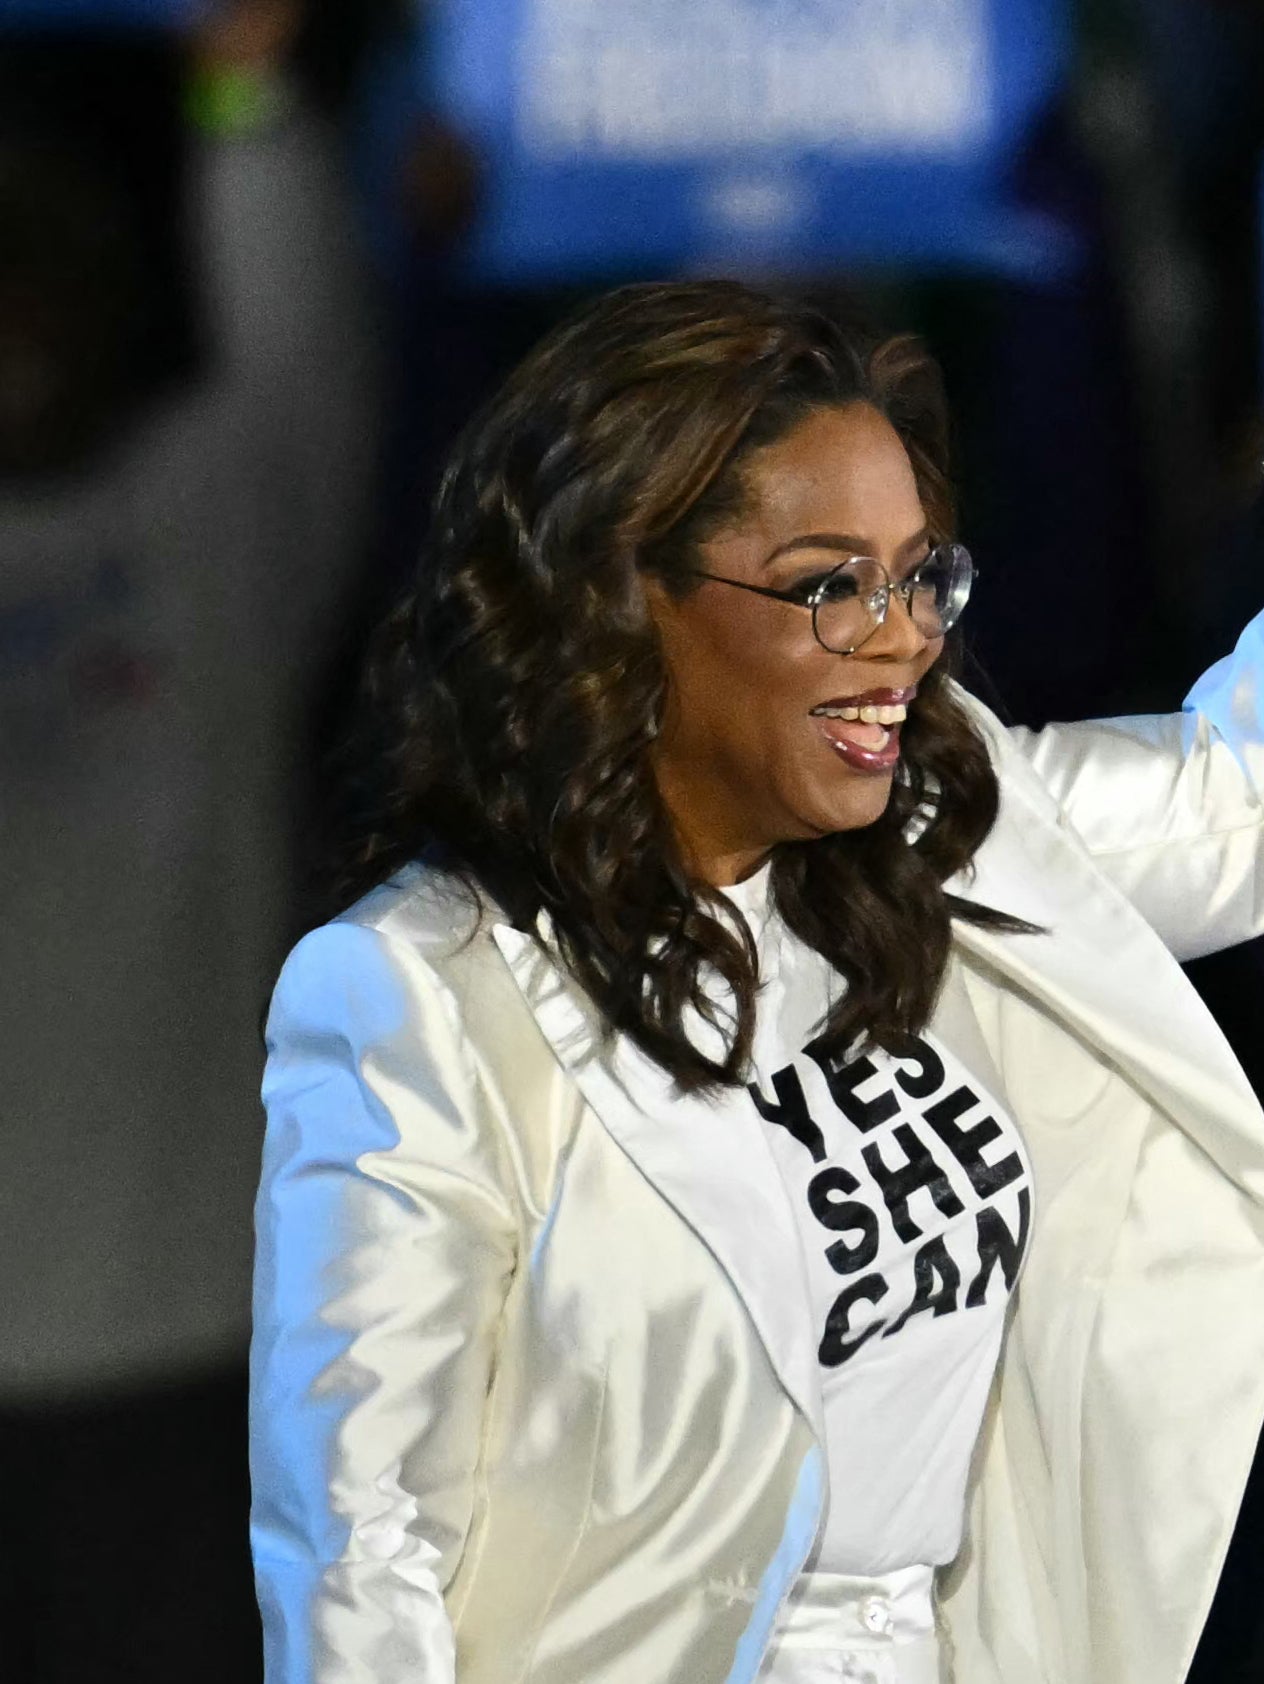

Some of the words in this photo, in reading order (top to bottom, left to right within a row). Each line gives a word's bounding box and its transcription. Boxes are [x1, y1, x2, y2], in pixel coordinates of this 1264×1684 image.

[748, 1033, 945, 1163] YES
[807, 1085, 1025, 1275] SHE
[818, 1185, 1030, 1367] CAN
